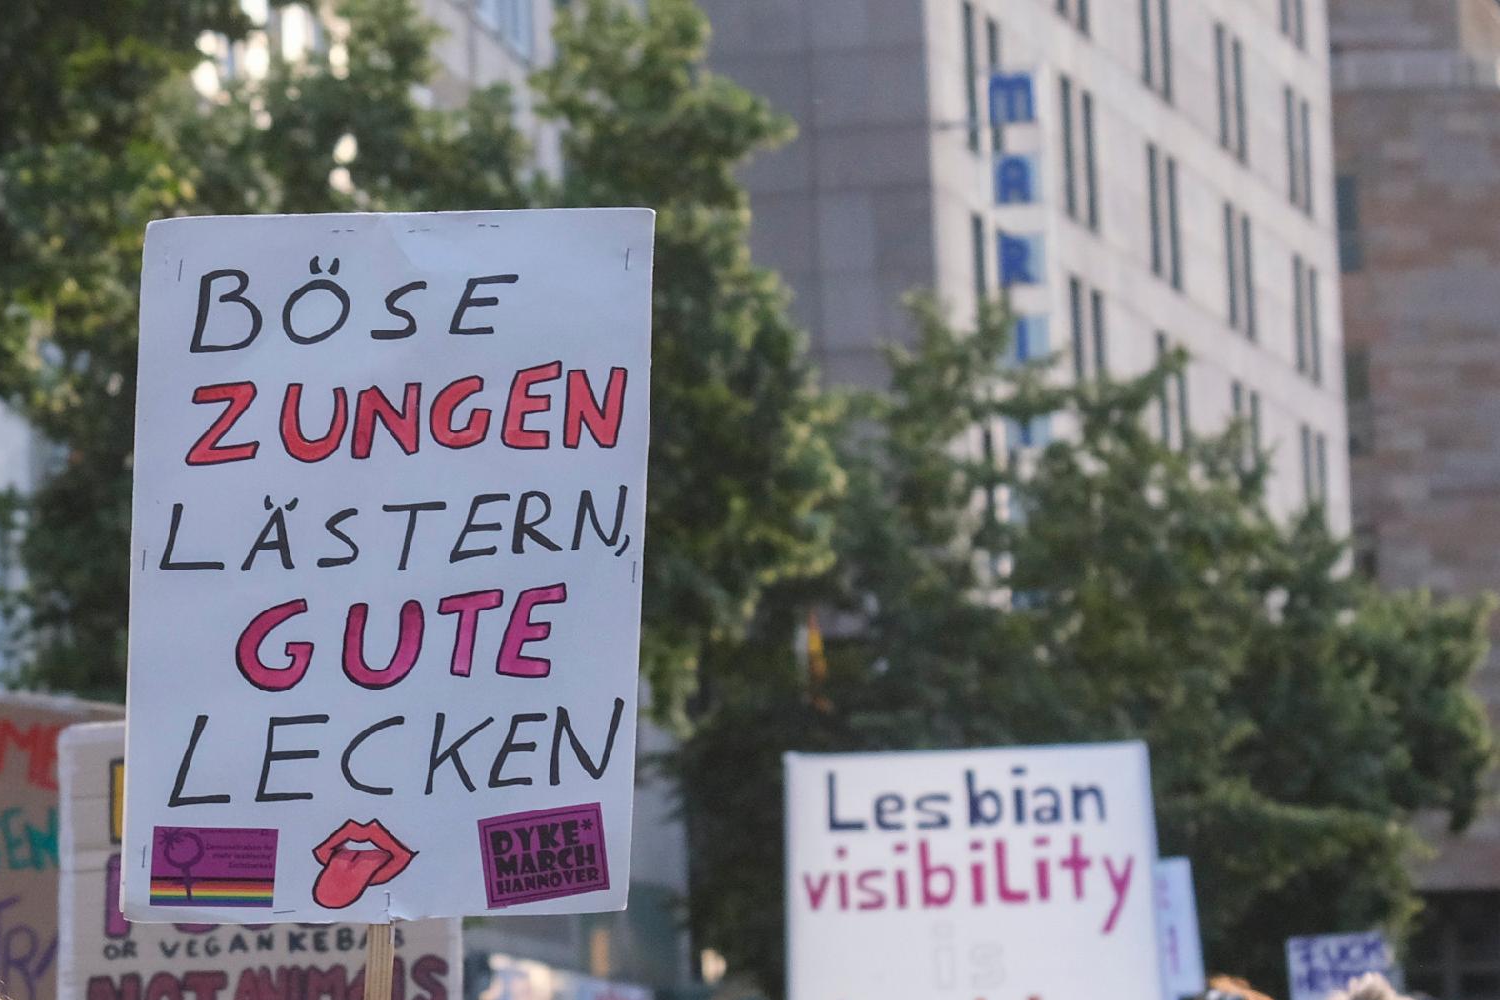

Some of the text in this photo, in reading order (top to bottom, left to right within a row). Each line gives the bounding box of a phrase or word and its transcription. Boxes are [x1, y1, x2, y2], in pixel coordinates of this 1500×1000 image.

[189, 255, 519, 353] BÖSE
[185, 360, 628, 466] ZUNGEN
[159, 484, 631, 571] LÄSTERN,
[235, 583, 568, 692] GUTE
[168, 697, 625, 807] LECKEN
[826, 767, 1107, 833] Lesbian
[494, 843, 596, 879] MARCH
[496, 867, 599, 895] HANNOVER
[103, 940, 138, 960] OR
[159, 929, 275, 959] VEGAN
